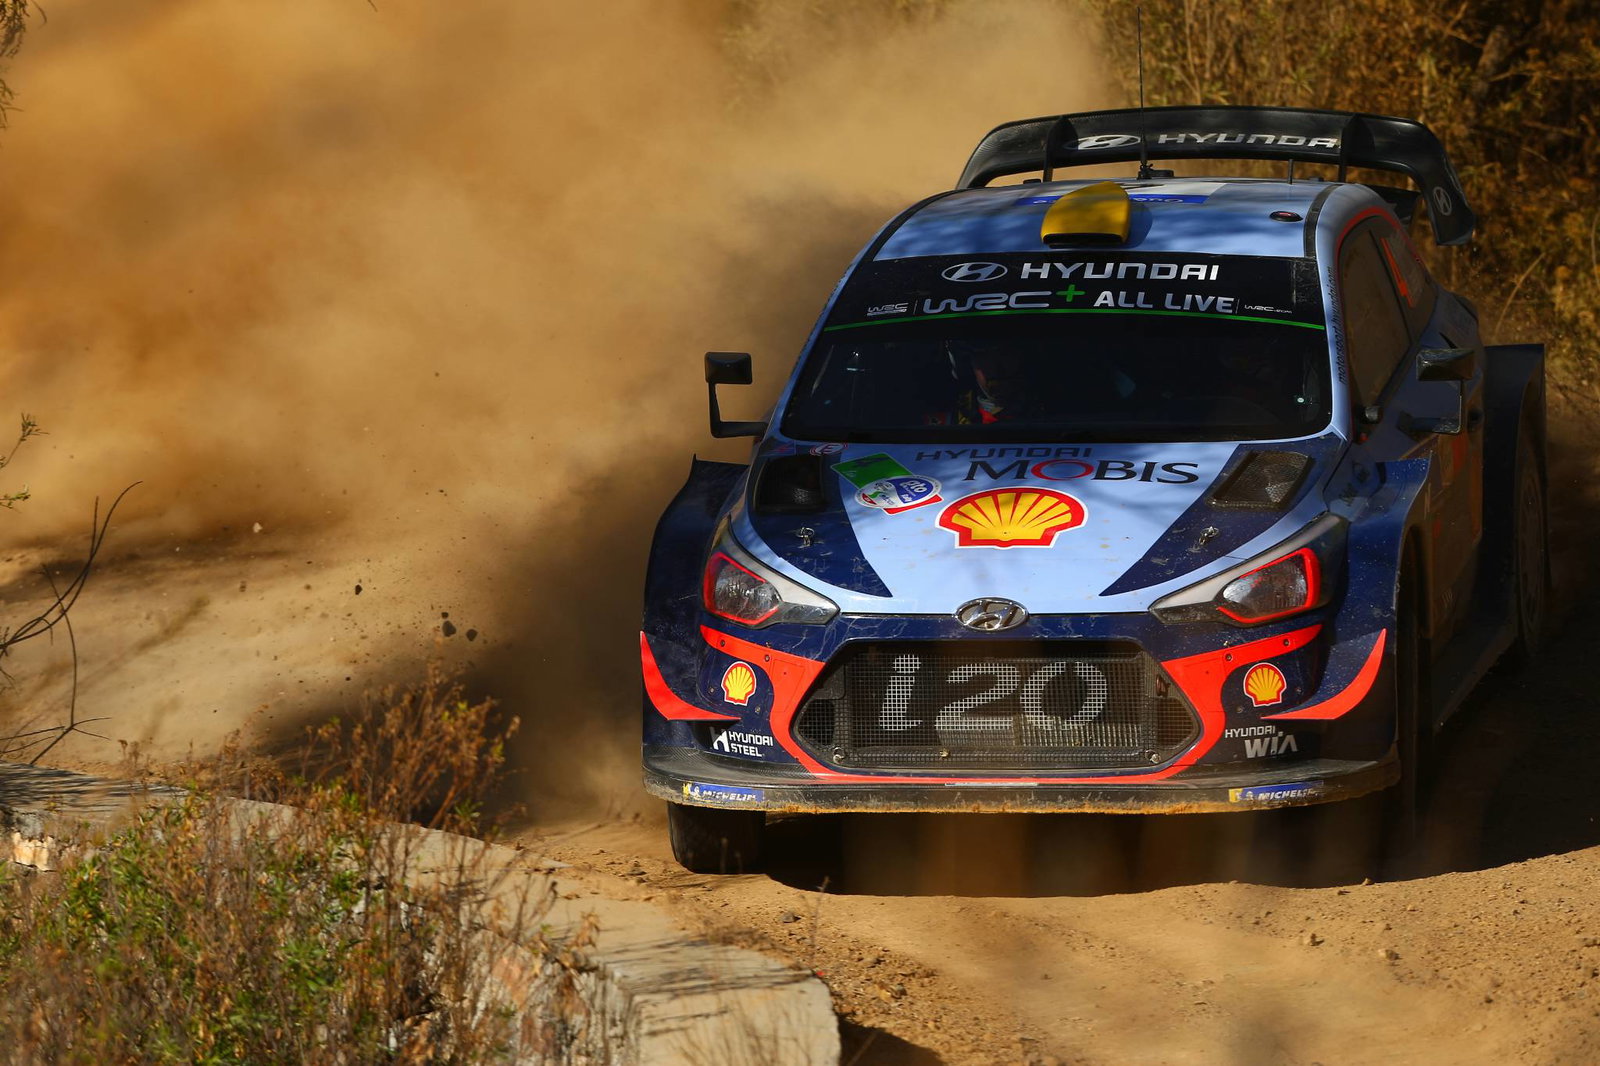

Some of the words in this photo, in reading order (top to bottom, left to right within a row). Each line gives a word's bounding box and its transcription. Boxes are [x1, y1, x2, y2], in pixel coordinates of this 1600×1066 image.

[1157, 132, 1341, 149] HYUNDA
[1020, 262, 1220, 281] HYUNDAI
[1093, 291, 1153, 308] ALL
[1164, 293, 1235, 314] LIVE
[916, 447, 1093, 461] HYUNDAI
[963, 459, 1199, 484] MOBIS
[728, 730, 774, 746] HYUNDAI
[1225, 725, 1276, 739] HYUNDAI
[730, 743, 763, 758] STEEL
